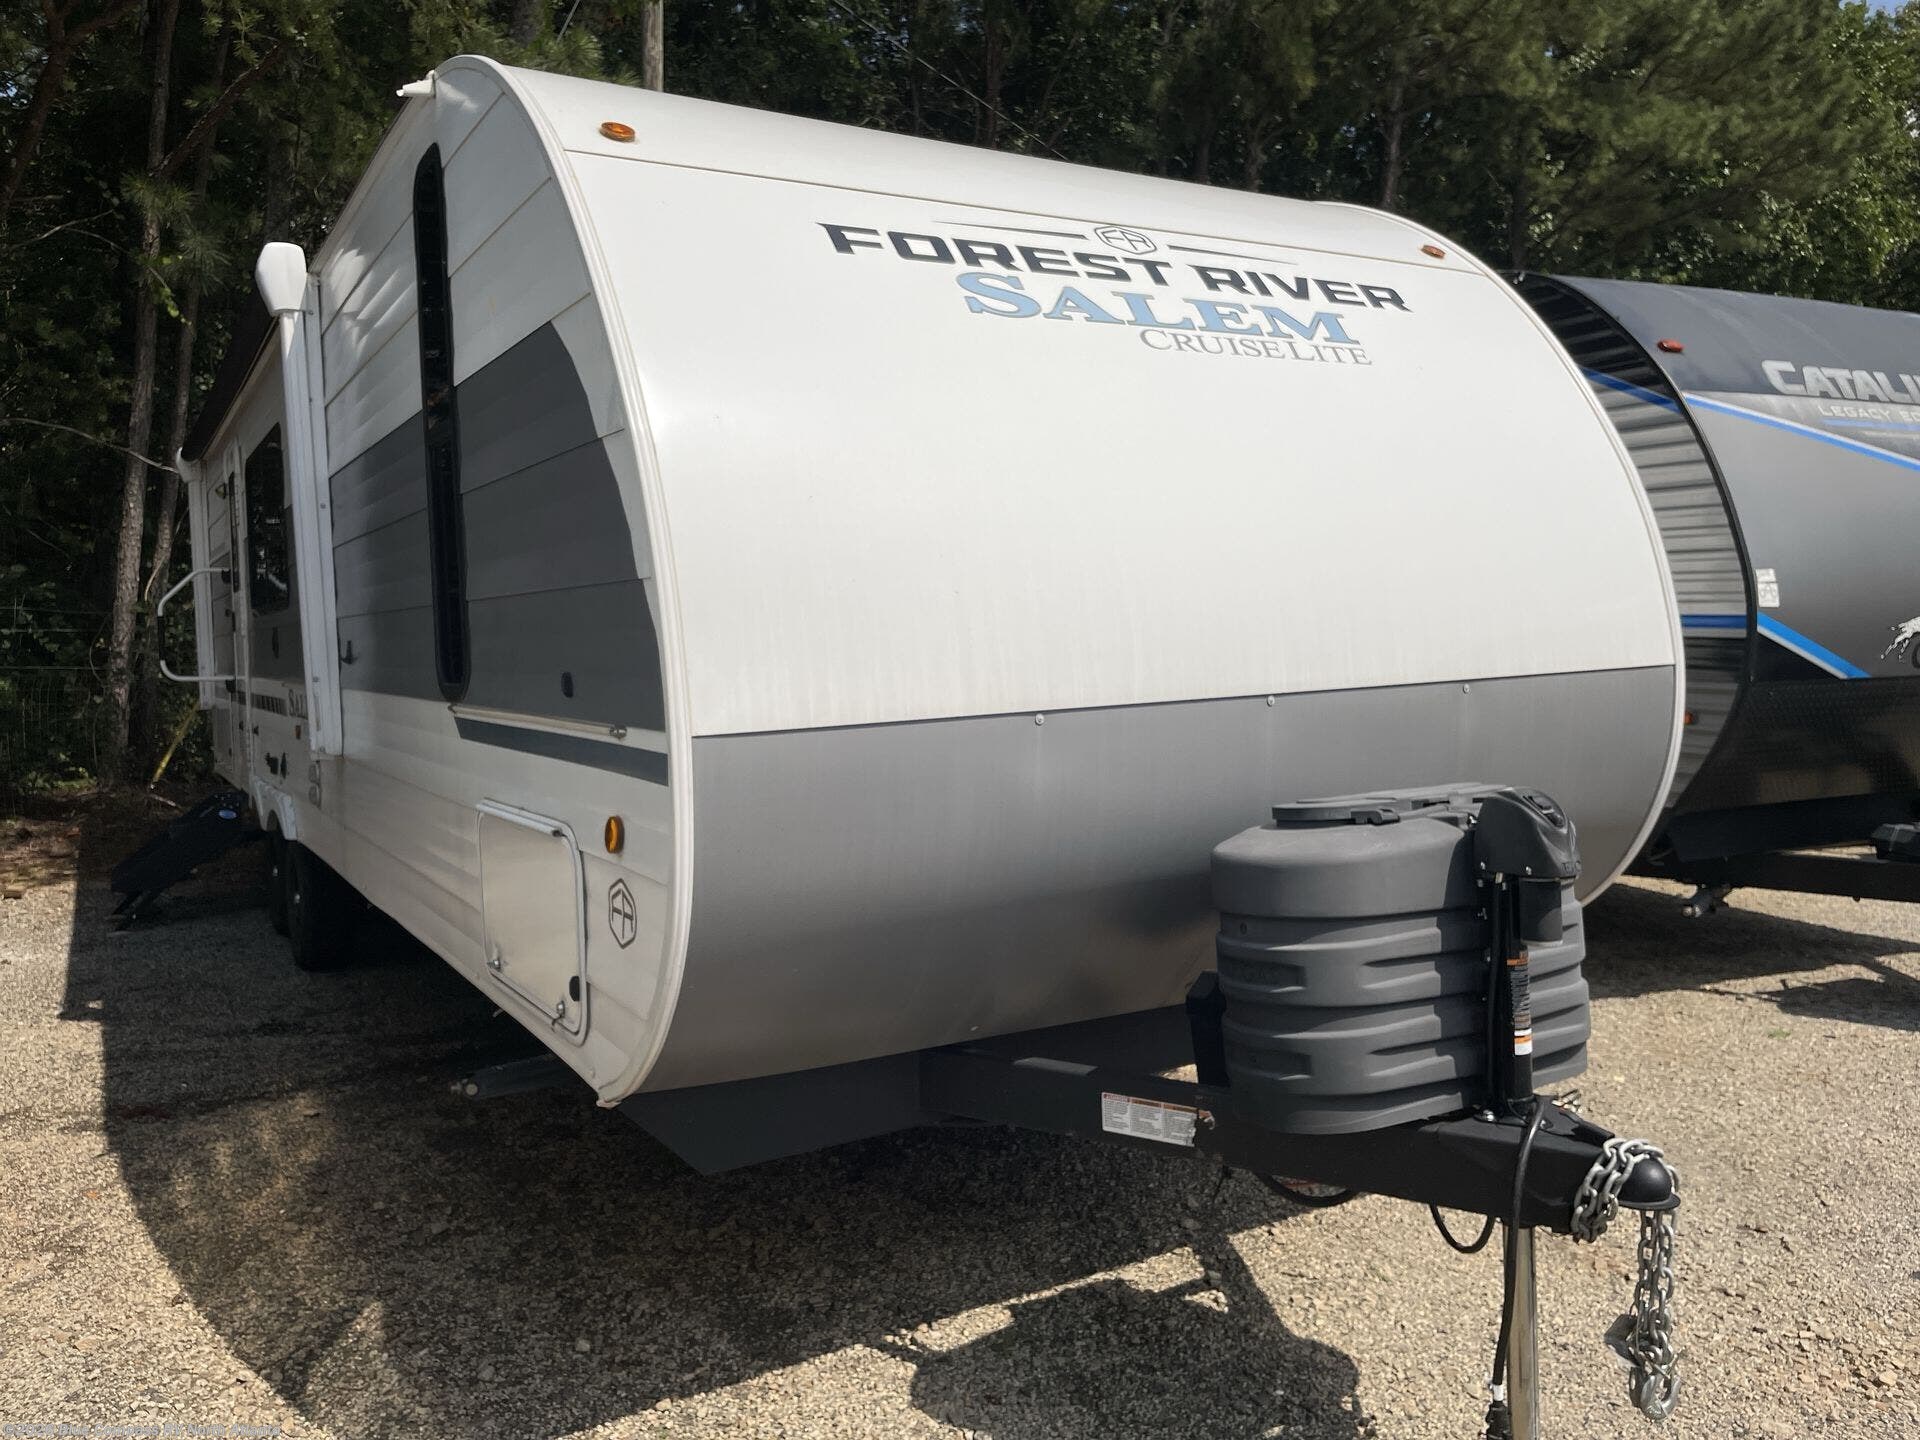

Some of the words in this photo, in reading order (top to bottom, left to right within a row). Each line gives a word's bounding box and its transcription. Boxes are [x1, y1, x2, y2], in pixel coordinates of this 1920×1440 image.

[815, 222, 1173, 287] FOREST
[1186, 263, 1414, 313] RIVER
[955, 271, 1361, 346] SALEM
[1817, 404, 1893, 424] LEGACY
